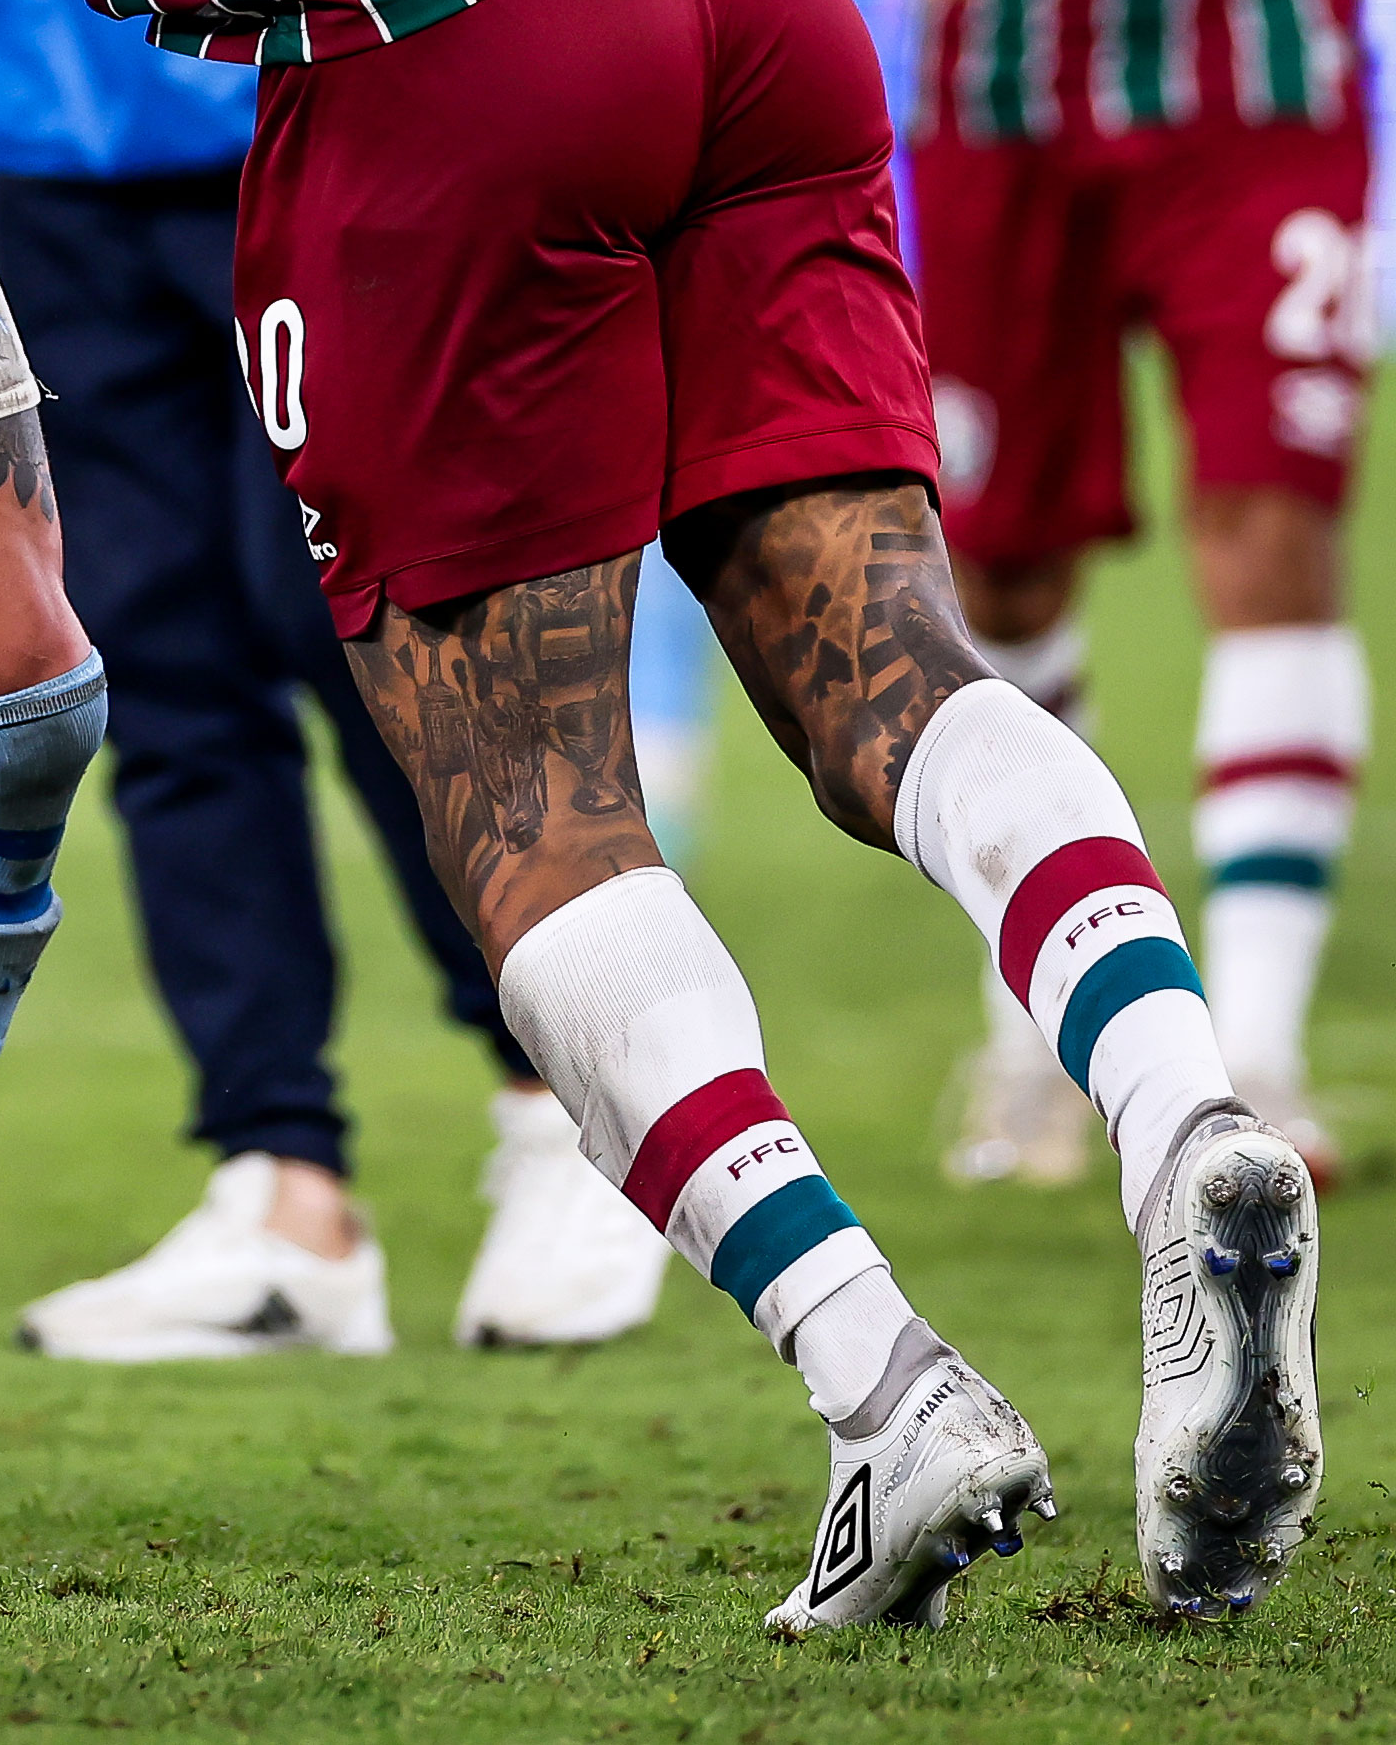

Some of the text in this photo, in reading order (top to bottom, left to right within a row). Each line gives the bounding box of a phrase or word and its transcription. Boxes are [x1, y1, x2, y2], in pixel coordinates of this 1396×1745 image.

[234, 298, 307, 450] 0
[1065, 902, 1144, 950] FFC
[727, 1137, 799, 1181] FFC
[902, 1381, 955, 1451] ADAMANT
